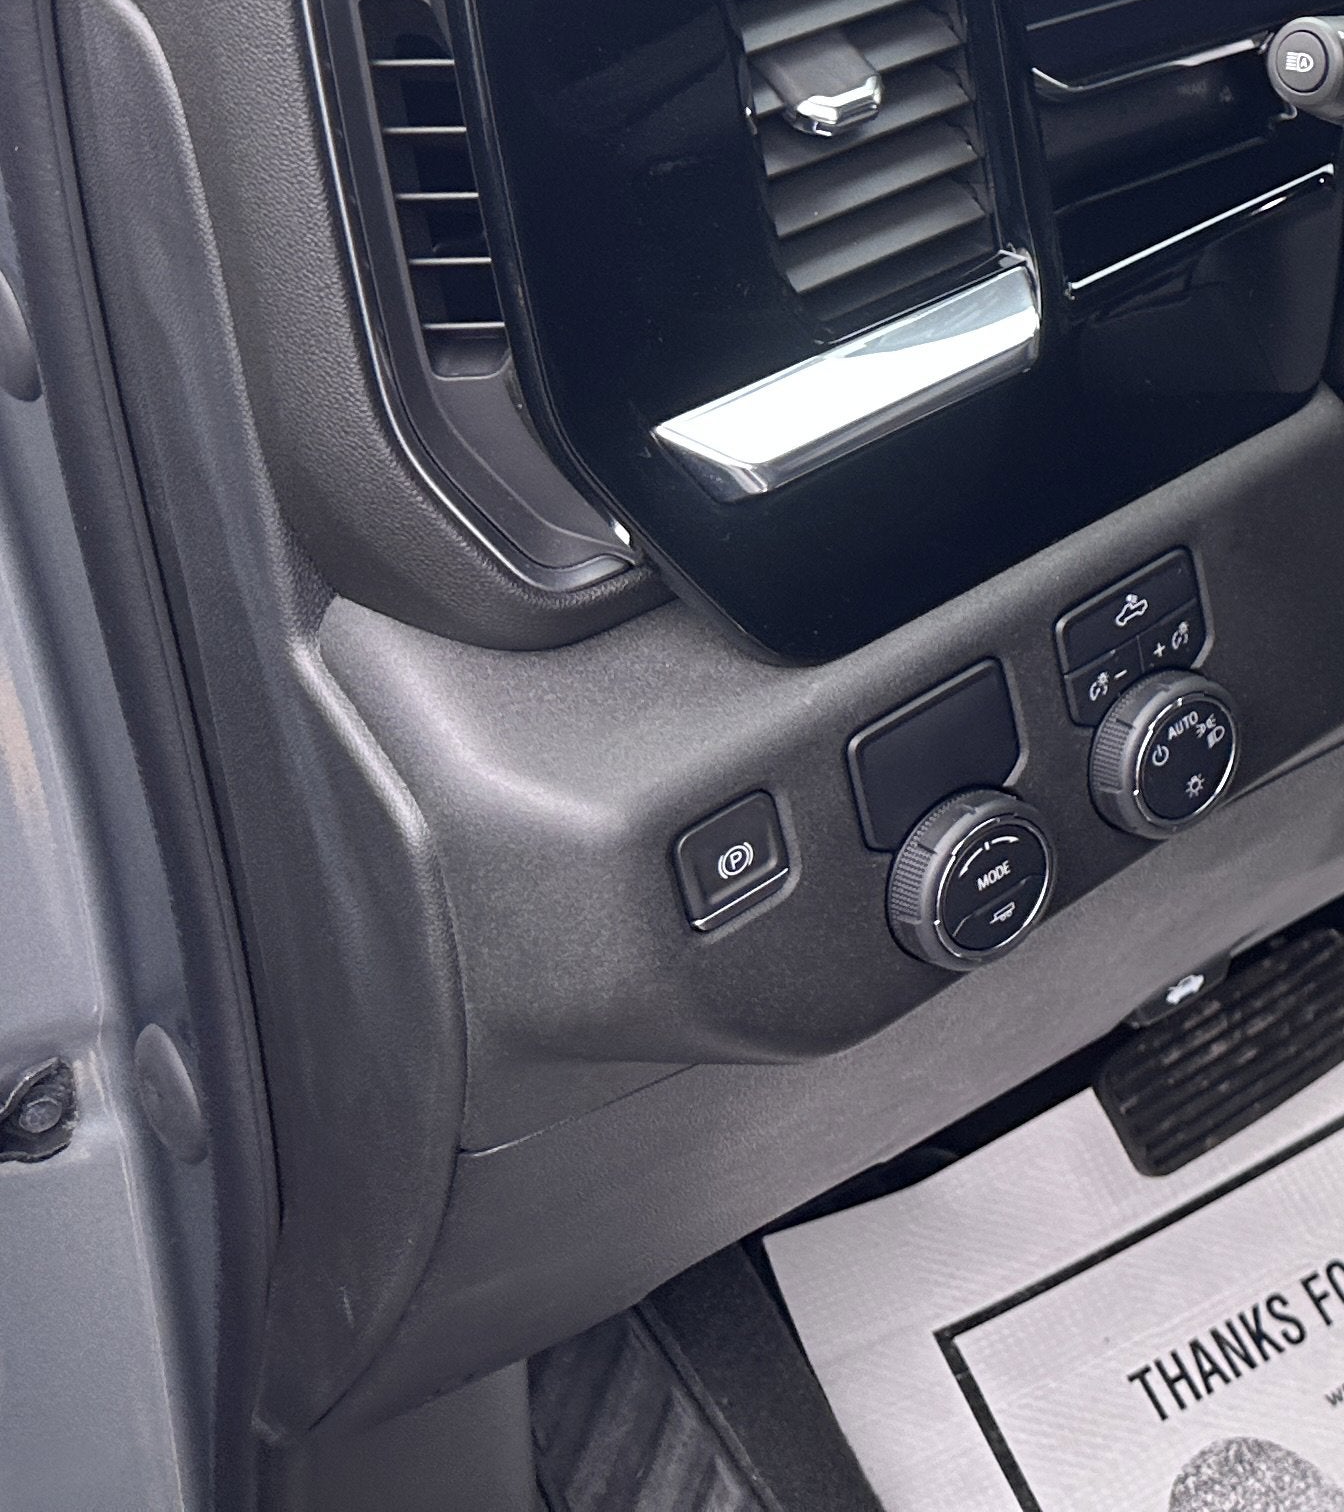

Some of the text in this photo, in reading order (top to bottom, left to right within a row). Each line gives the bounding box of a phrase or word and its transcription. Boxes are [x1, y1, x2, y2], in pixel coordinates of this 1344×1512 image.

[1168, 711, 1199, 741] AUTO
[977, 860, 1011, 891] MODE
[1127, 1291, 1308, 1422] THANKS
